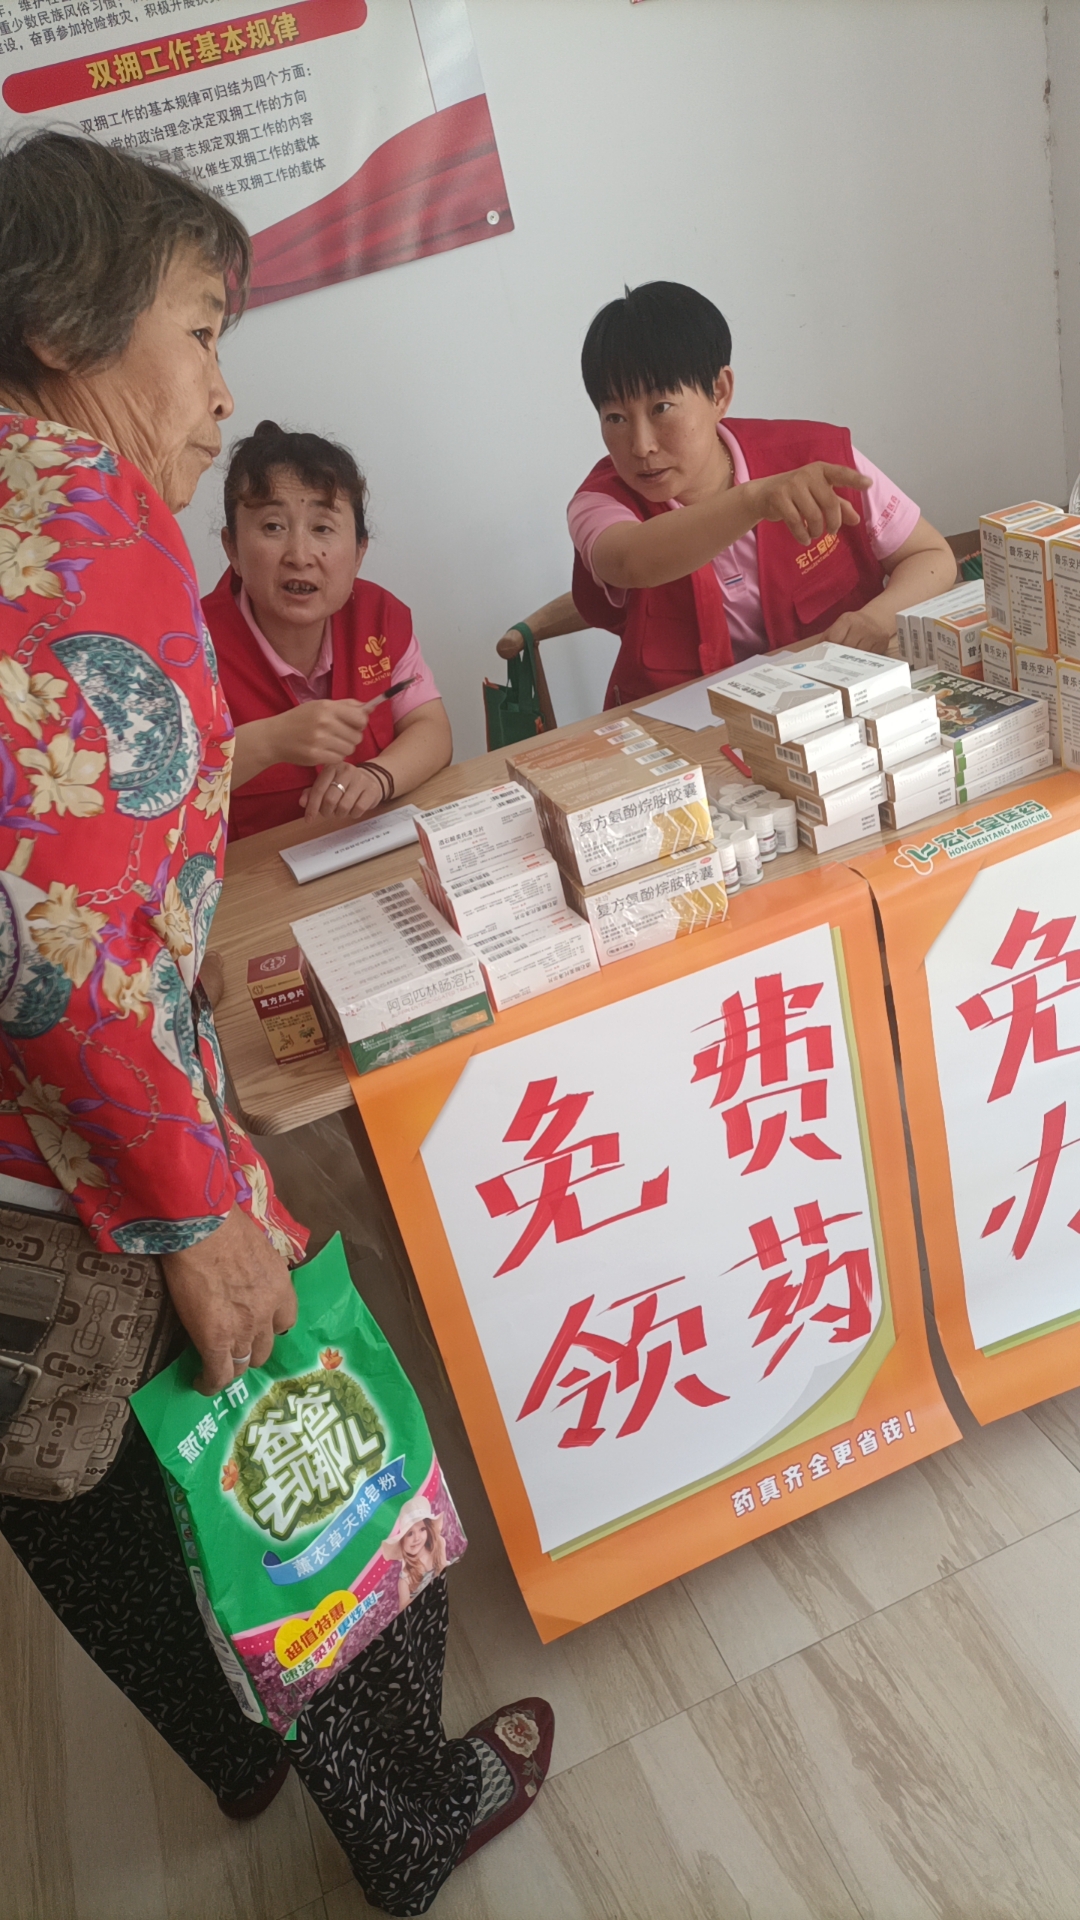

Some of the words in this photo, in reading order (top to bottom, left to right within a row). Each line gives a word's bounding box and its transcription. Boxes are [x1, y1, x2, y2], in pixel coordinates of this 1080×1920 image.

[86, 12, 301, 90] 双拥工作基本规律
[80, 63, 312, 135] 双拥工作的基本规律可归结为四个方面：
[136, 112, 314, 168] 主导意志规定双拥工作的内容
[1009, 545, 1039, 562] 普乐安片
[1020, 660, 1054, 677] 普乐安片
[1062, 673, 1080, 688] 普乐
[934, 800, 1044, 849] 宏仁堂医药
[949, 827, 1011, 858] HONGRENTANG
[1011, 810, 1051, 833] MEDICINE
[386, 969, 476, 1013] 阿司匹林肠溶片
[177, 1378, 249, 1464] 新装上市
[731, 1409, 917, 1517] 药真齐全更省钱！
[284, 1600, 346, 1662] 超值特惠
